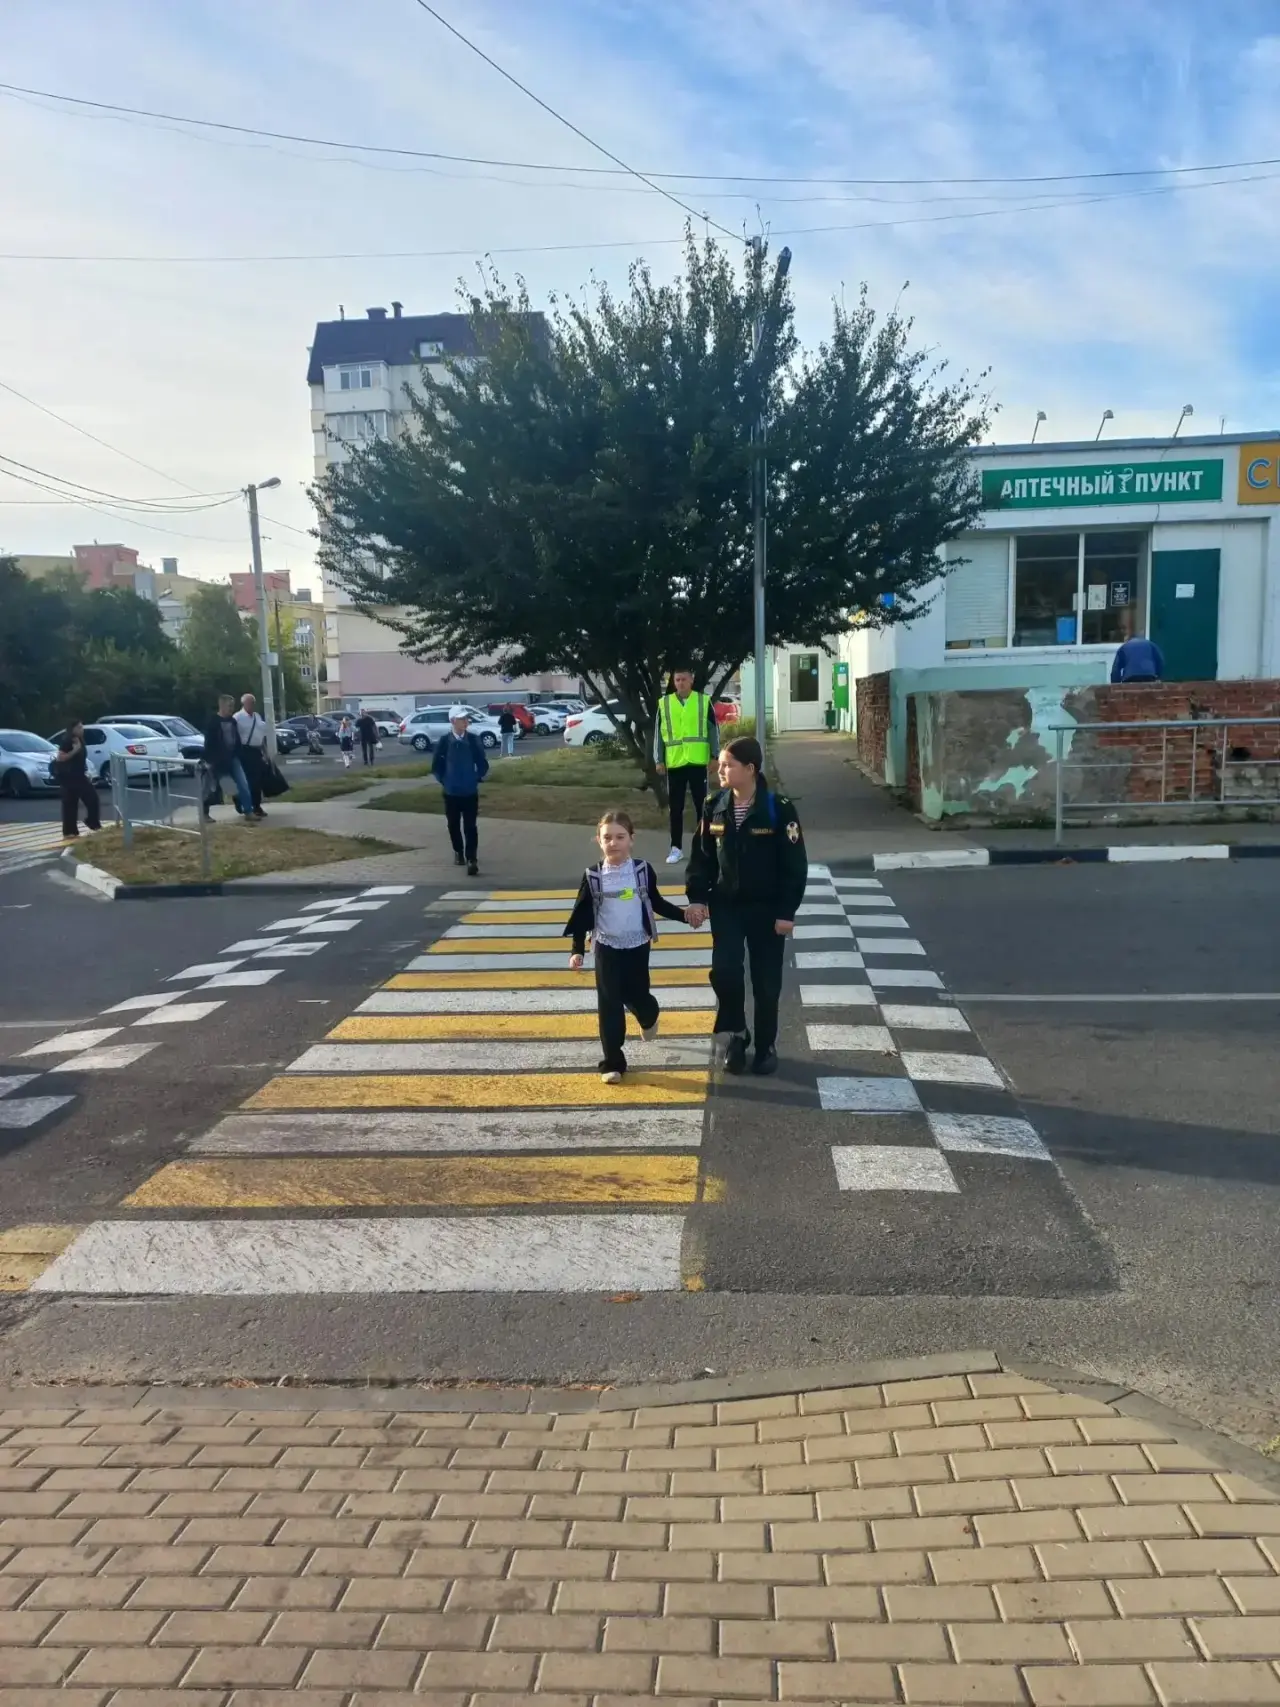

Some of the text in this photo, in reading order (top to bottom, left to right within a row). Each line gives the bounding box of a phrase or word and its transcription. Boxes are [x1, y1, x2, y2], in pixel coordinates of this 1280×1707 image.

[1000, 469, 1204, 498] АПТЕЧНЫЙ ПУНКТ
[1246, 455, 1280, 489] С
